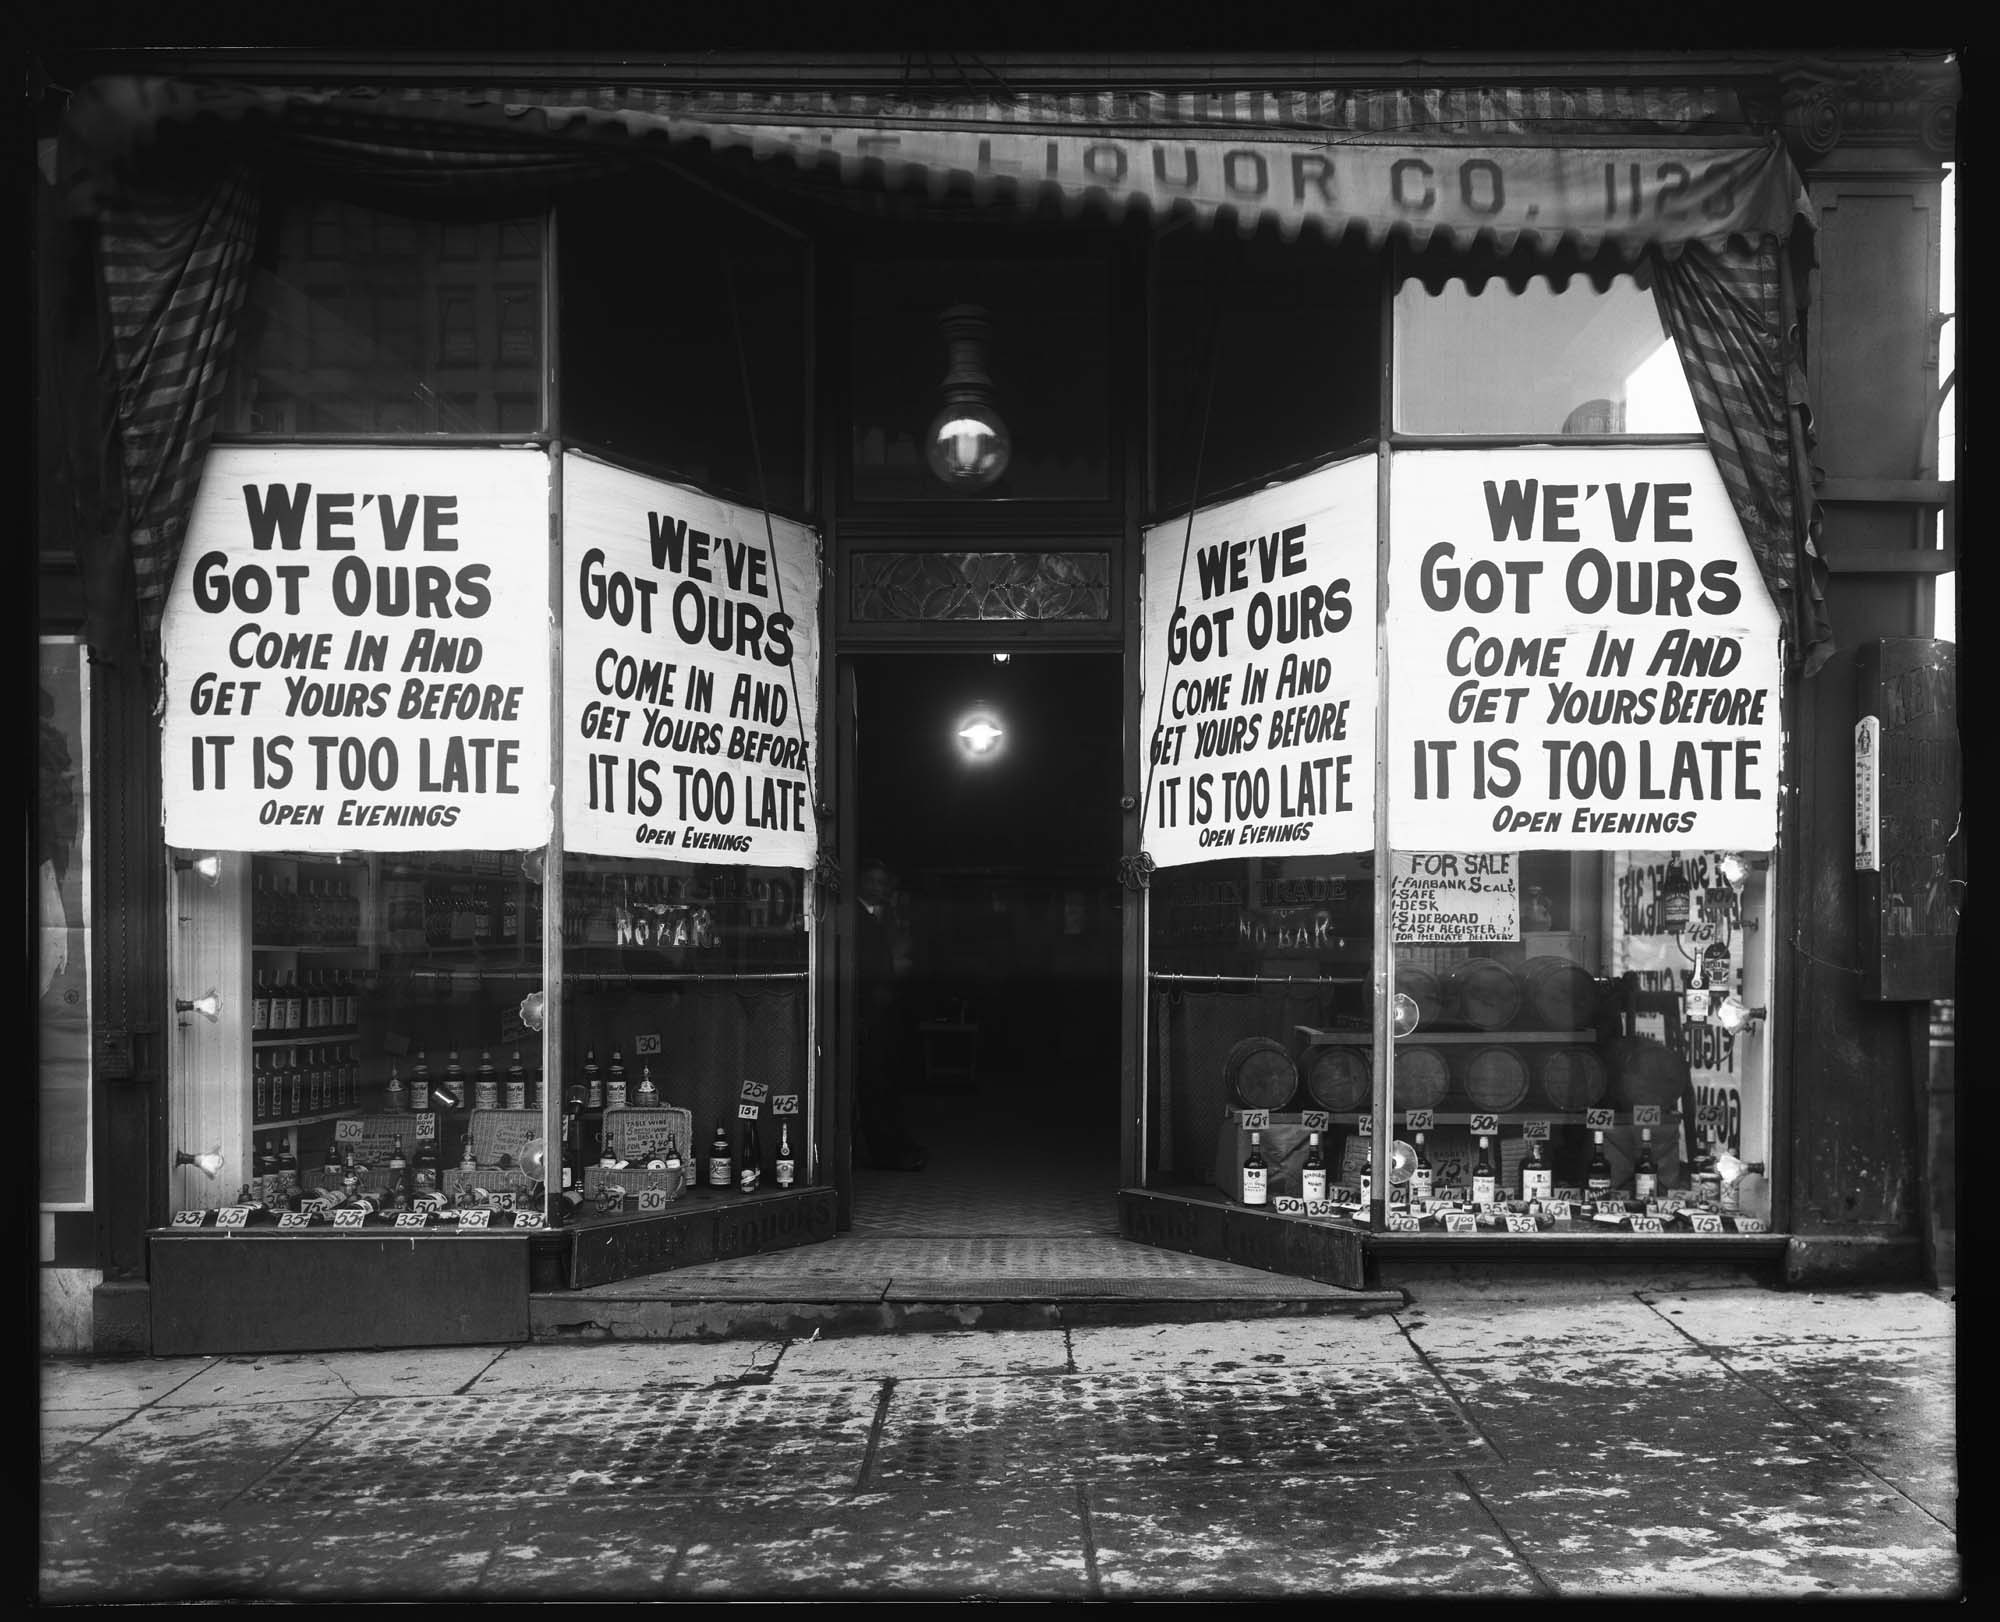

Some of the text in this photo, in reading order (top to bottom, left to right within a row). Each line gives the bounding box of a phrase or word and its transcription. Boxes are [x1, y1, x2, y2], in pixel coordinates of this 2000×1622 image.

[1390, 158, 1538, 217] CO.
[242, 483, 458, 551] WE'VE
[1483, 478, 1692, 542] WE'VE
[648, 511, 768, 597] WE'VE
[1197, 524, 1306, 600] WE'VE
[193, 551, 491, 619] GOT OURS
[1420, 541, 1741, 617] GOT OURS
[580, 548, 794, 666] GOT OURS
[1168, 578, 1352, 665] GOT OURS
[229, 623, 482, 673] COME IN AND
[1446, 626, 1741, 678] COME IN AND
[596, 648, 787, 727] COME IN AND
[1172, 653, 1332, 719] COME IN AND
[190, 672, 523, 721] GET YOURS BEFORE
[1448, 680, 1768, 726] GET YOURS BEFORE
[580, 701, 809, 771] GET YOURS BEFORE
[1150, 700, 1350, 766] GET YOURS BEFORE
[192, 735, 519, 793] IT IS TOO LATE
[1414, 738, 1761, 800] IT IS TOO LATE
[589, 753, 806, 832] IT IS TOO LATE
[1159, 754, 1352, 828] IT IS TOO LATE
[259, 800, 460, 826] OPEN EVENINGS
[1492, 806, 1697, 834] OPEN EVENINGS
[635, 823, 752, 852] OPEN EVENINGS
[1199, 821, 1313, 847] OPEN EVENINGS
[1411, 854, 1510, 877] FOR SALE
[1396, 933, 1413, 941] FOR
[1469, 933, 1514, 941] DELIVERY
[1440, 924, 1496, 934] REGISTER
[640, 1038, 660, 1051] 30¢
[743, 1082, 766, 1097] 25¢
[740, 1107, 757, 1116] 15¢
[773, 1097, 798, 1111] 45¢
[1244, 1113, 1268, 1127] 75¢
[1304, 1113, 1327, 1128] 75¢
[1407, 1112, 1431, 1127] 75¢
[1472, 1116, 1498, 1130] 50¢
[1588, 1111, 1612, 1125] 65¢
[1636, 1107, 1659, 1123] 75¢
[339, 1123, 361, 1138] 30¢
[417, 1126, 433, 1136] 50¢
[1437, 1159, 1470, 1177] 75¢
[641, 1193, 665, 1208] 30¢
[1390, 1190, 1406, 1203] 0¢
[415, 1201, 436, 1212] 50
[1278, 1200, 1303, 1211] 50¢
[1309, 1201, 1330, 1215] 35
[1545, 1203, 1569, 1216] 65¢
[174, 1211, 203, 1225] 35¢
[218, 1209, 246, 1226] 65¢
[281, 1213, 311, 1226] 35¢
[335, 1211, 364, 1226] 55¢
[397, 1213, 426, 1226] 35¢
[459, 1211, 488, 1226] 65¢
[1509, 1219, 1535, 1232] 35¢
[1695, 1217, 1721, 1231] 75¢
